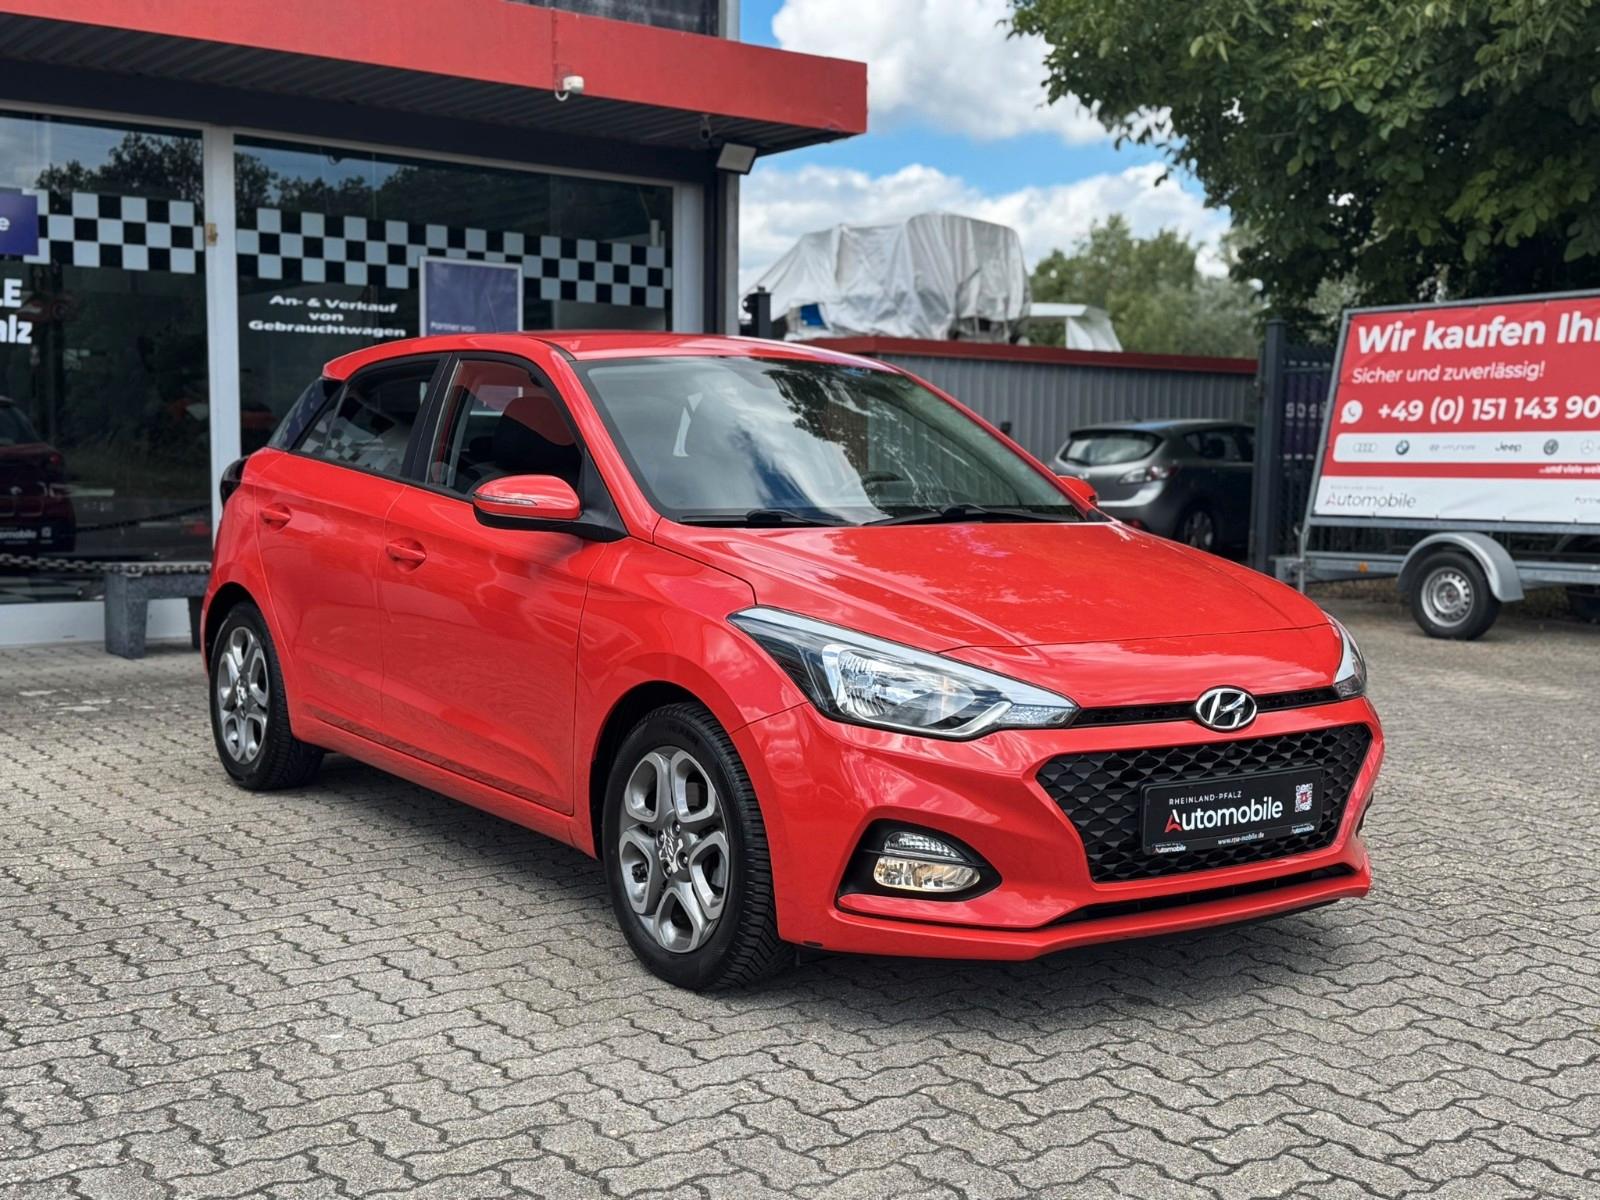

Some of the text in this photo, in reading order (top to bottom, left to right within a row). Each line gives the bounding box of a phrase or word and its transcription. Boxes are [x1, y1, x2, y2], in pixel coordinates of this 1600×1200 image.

[269, 295, 397, 313] An- & Verkauf
[308, 312, 344, 321] von
[248, 320, 406, 338] Gebrauchtwagen
[1358, 320, 1416, 354] Wir
[1422, 315, 1546, 351] kaufen
[1352, 360, 1546, 384] Sicher und zuverlässig!
[1378, 395, 1600, 424] +49 (0) 151 143 90
[1495, 440, 1522, 452] Jeep
[1325, 492, 1416, 508] Automobile
[1168, 790, 1243, 806] RHEINLAND-PFALZ
[1164, 796, 1284, 833] Automobile
